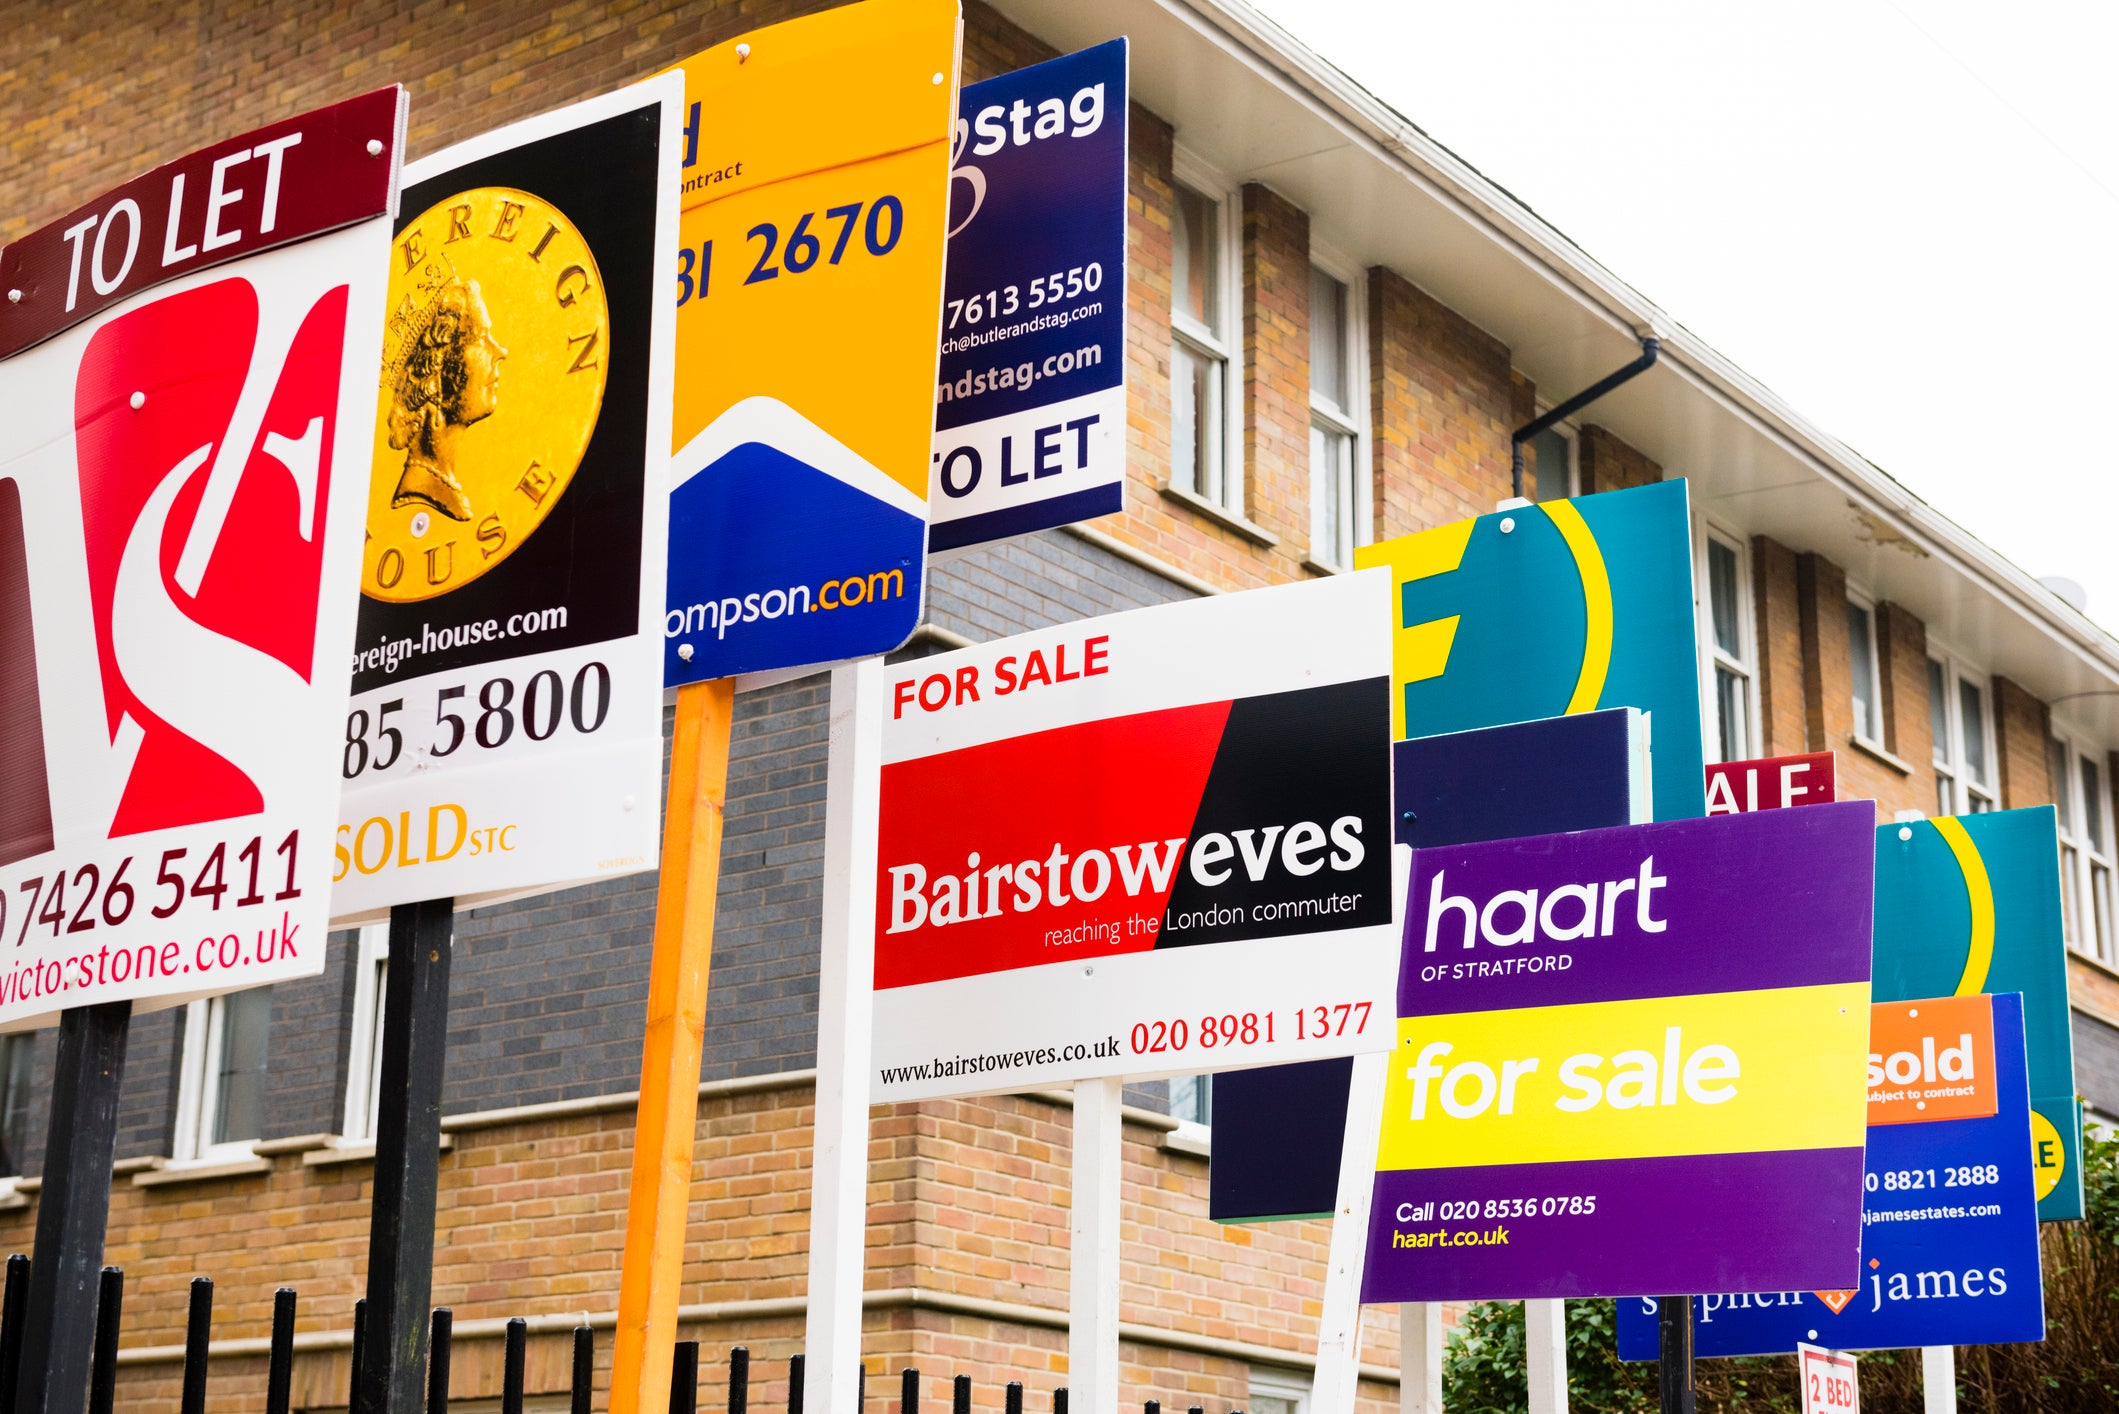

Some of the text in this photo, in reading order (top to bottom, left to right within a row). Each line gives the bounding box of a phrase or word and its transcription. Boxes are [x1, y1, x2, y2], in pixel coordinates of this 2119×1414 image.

[972, 82, 1104, 156] Stag
[63, 131, 303, 313] TO LET
[743, 194, 904, 286] 2670
[947, 261, 1103, 329] 7613 5550
[933, 412, 1101, 499] O LET
[365, 460, 557, 589] OUSE
[351, 605, 568, 676] ereign-house.com
[664, 568, 905, 640] ompson.com
[893, 634, 1110, 720] FOR SALE
[342, 661, 612, 780] 85 5800
[332, 803, 518, 883] SOLD STC
[16, 855, 136, 948] 7426
[150, 828, 302, 919] 5411
[1044, 891, 1363, 948] reaching the London commuter
[1424, 854, 1668, 953] haart
[1420, 954, 1573, 982] OF STRATFORD
[880, 1000, 1373, 1085] www.bairstoweves.co.uk 020 8981 1377
[1406, 1026, 1741, 1121] for sale
[1867, 1033, 1975, 1088] sold
[1906, 1089, 1921, 1100] to
[1923, 1085, 1975, 1099] contract
[1396, 1195, 1597, 1223] Call 020 8536 0785
[1883, 1168, 1936, 1191] 8821
[1943, 1164, 1999, 1188] 2888
[1392, 1225, 1510, 1249] haart.co.uk
[1868, 1257, 2008, 1313] james
[1810, 1373, 1852, 1408] 2 BED
